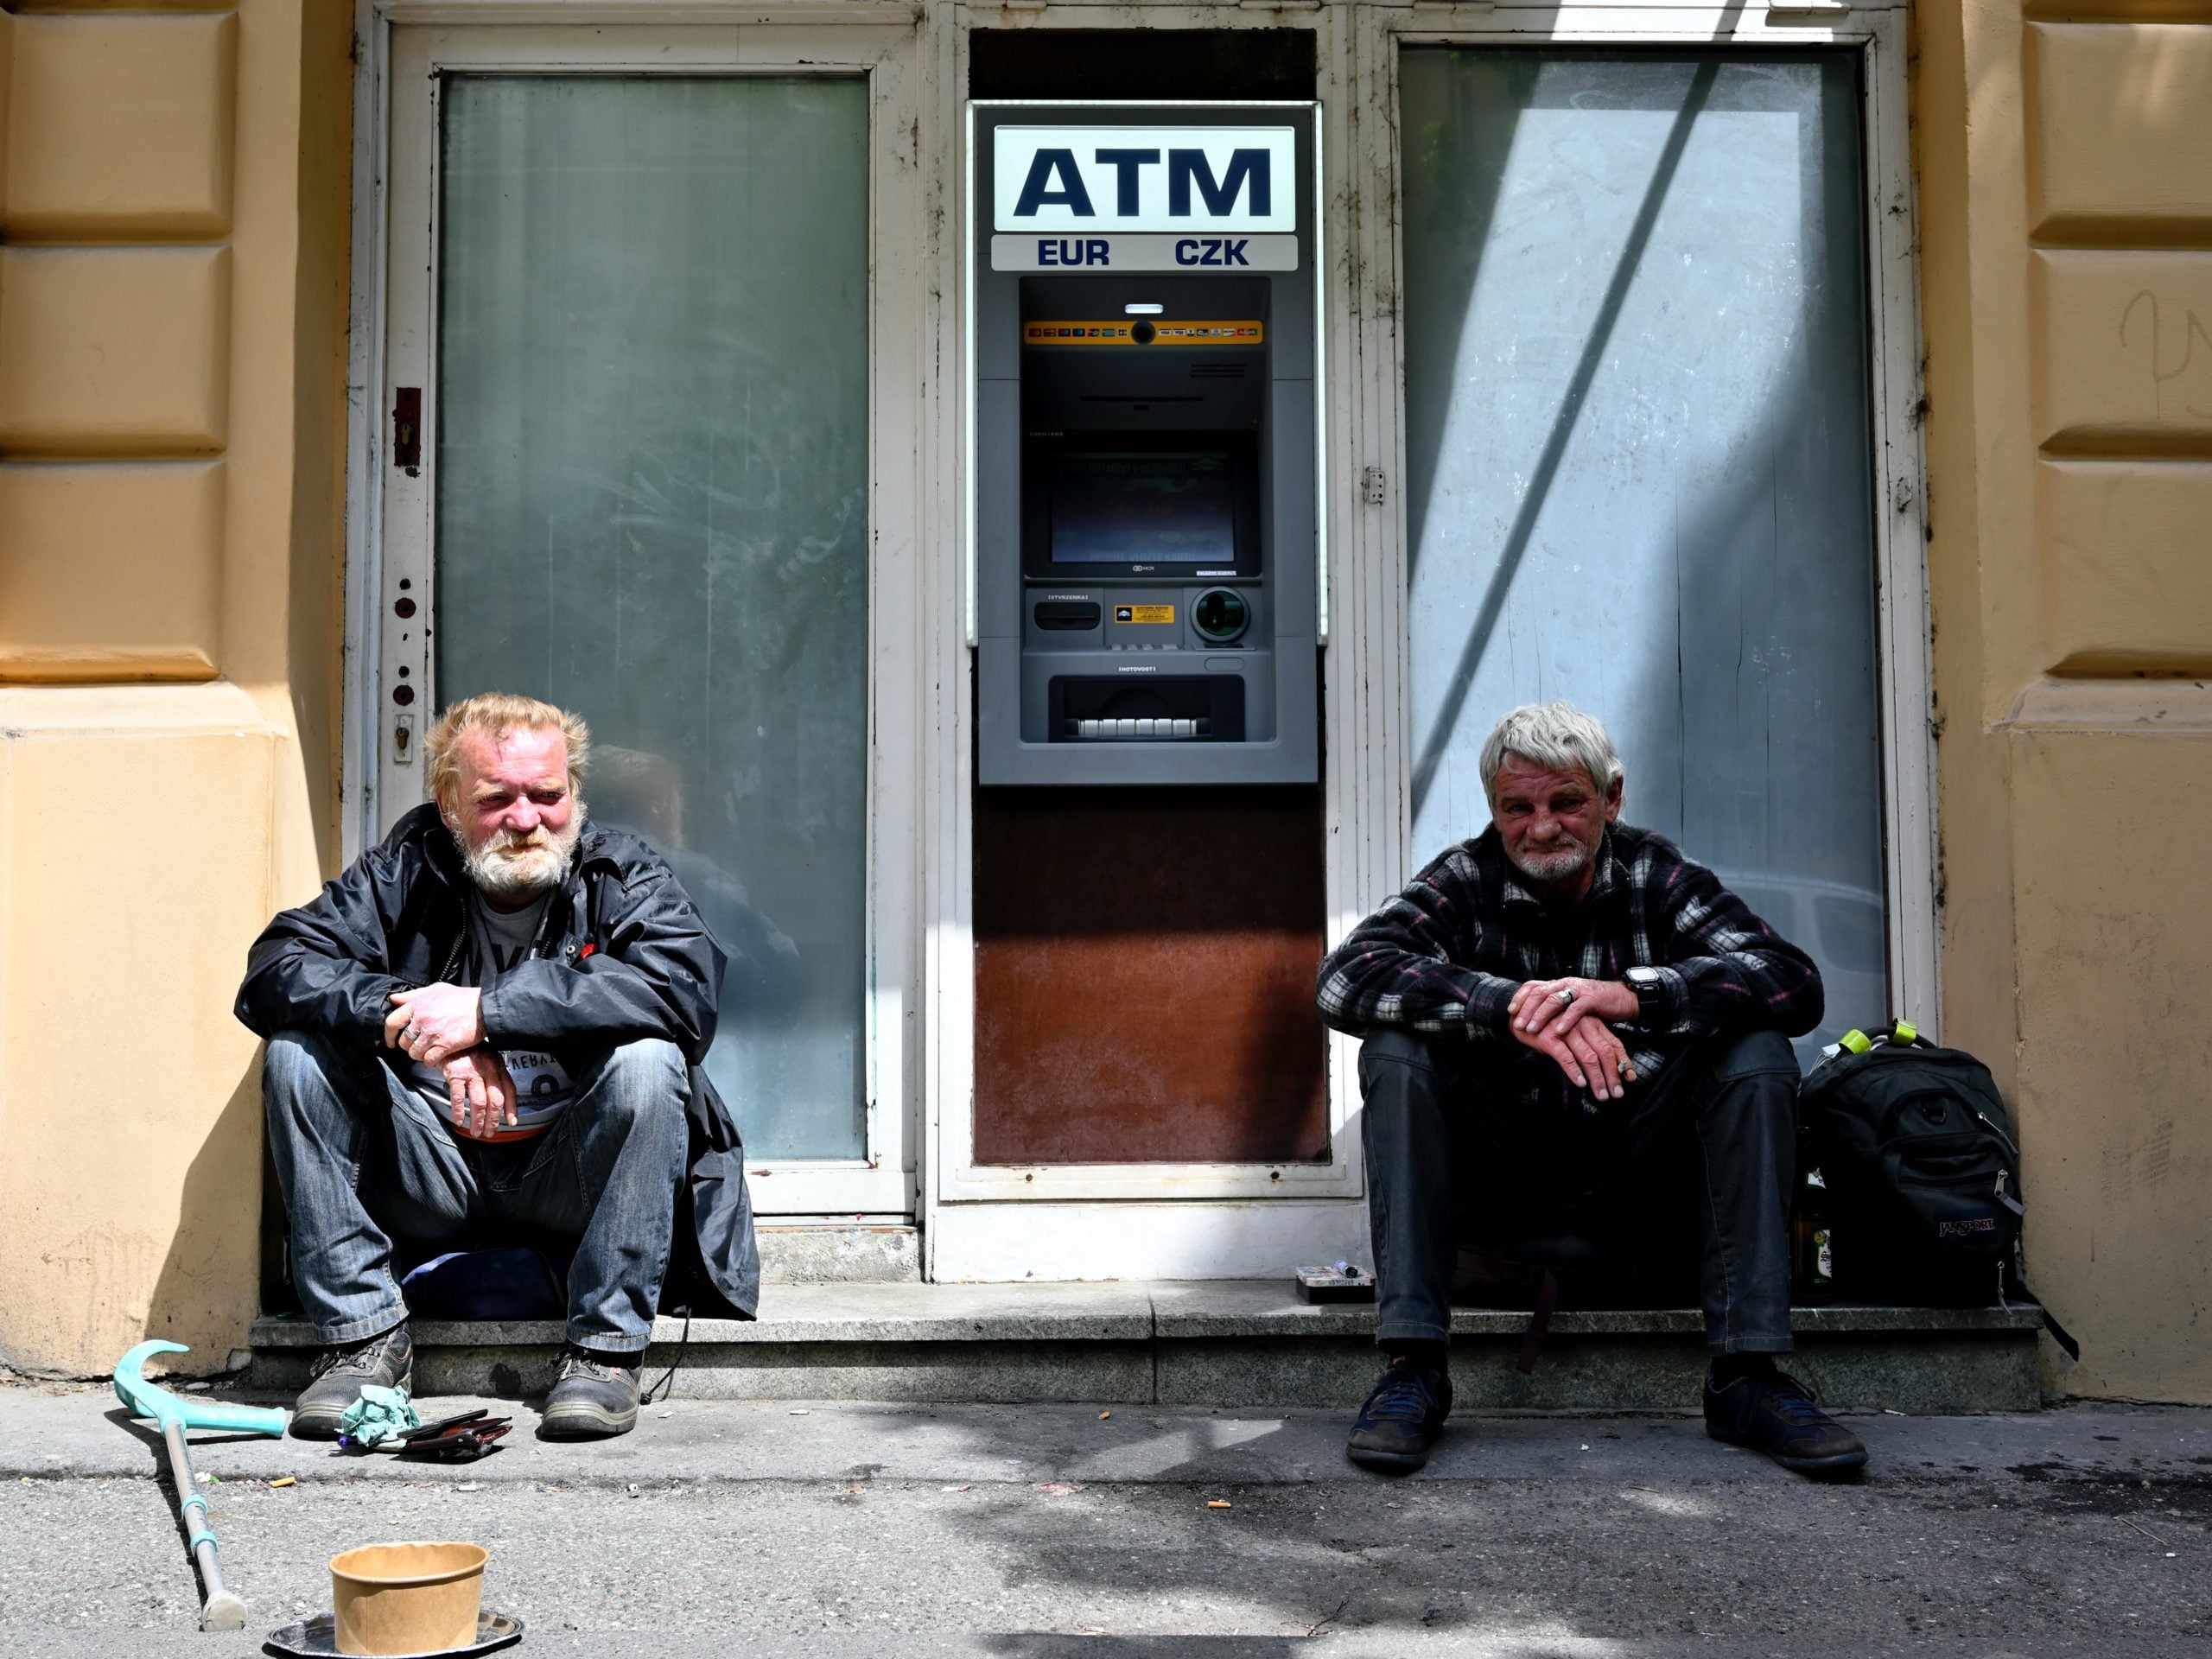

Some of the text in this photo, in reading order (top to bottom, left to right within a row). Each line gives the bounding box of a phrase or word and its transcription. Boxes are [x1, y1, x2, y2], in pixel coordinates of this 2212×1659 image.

[1013, 148, 1271, 217] ATM
[1038, 239, 1109, 265] EUR
[1175, 239, 1249, 266] CZK
